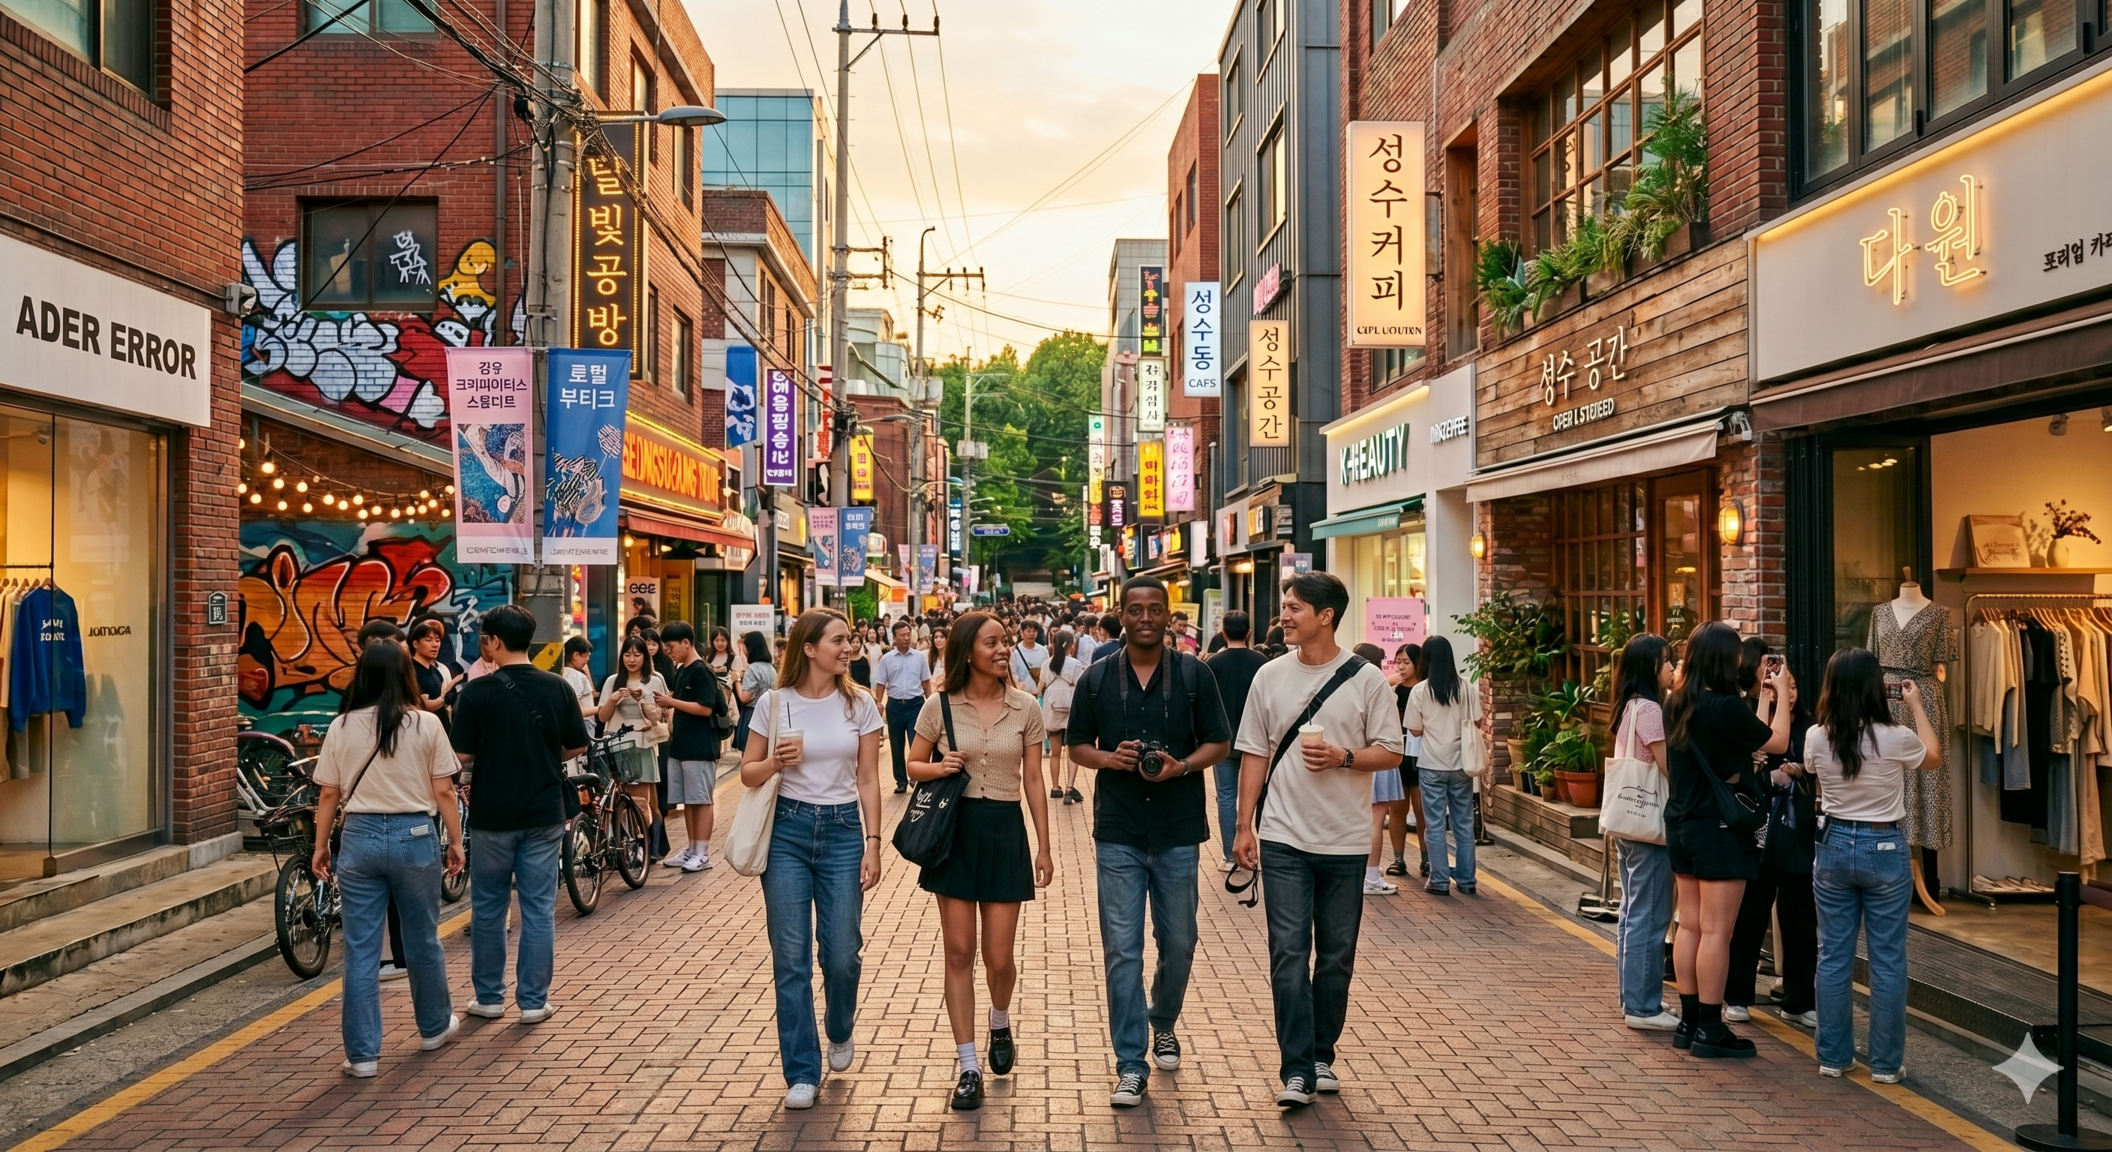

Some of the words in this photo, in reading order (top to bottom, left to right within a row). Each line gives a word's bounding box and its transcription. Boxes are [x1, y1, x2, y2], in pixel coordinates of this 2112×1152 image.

[1369, 133, 1408, 312] 성수커피
[16, 295, 101, 355] ADER
[110, 321, 197, 380] ERROR
[1191, 289, 1214, 371] 성수동
[1583, 325, 1629, 391] 공간
[559, 387, 616, 410] 부티크
[1188, 379, 1217, 388] CAFS
[1257, 326, 1283, 439] 성수공간
